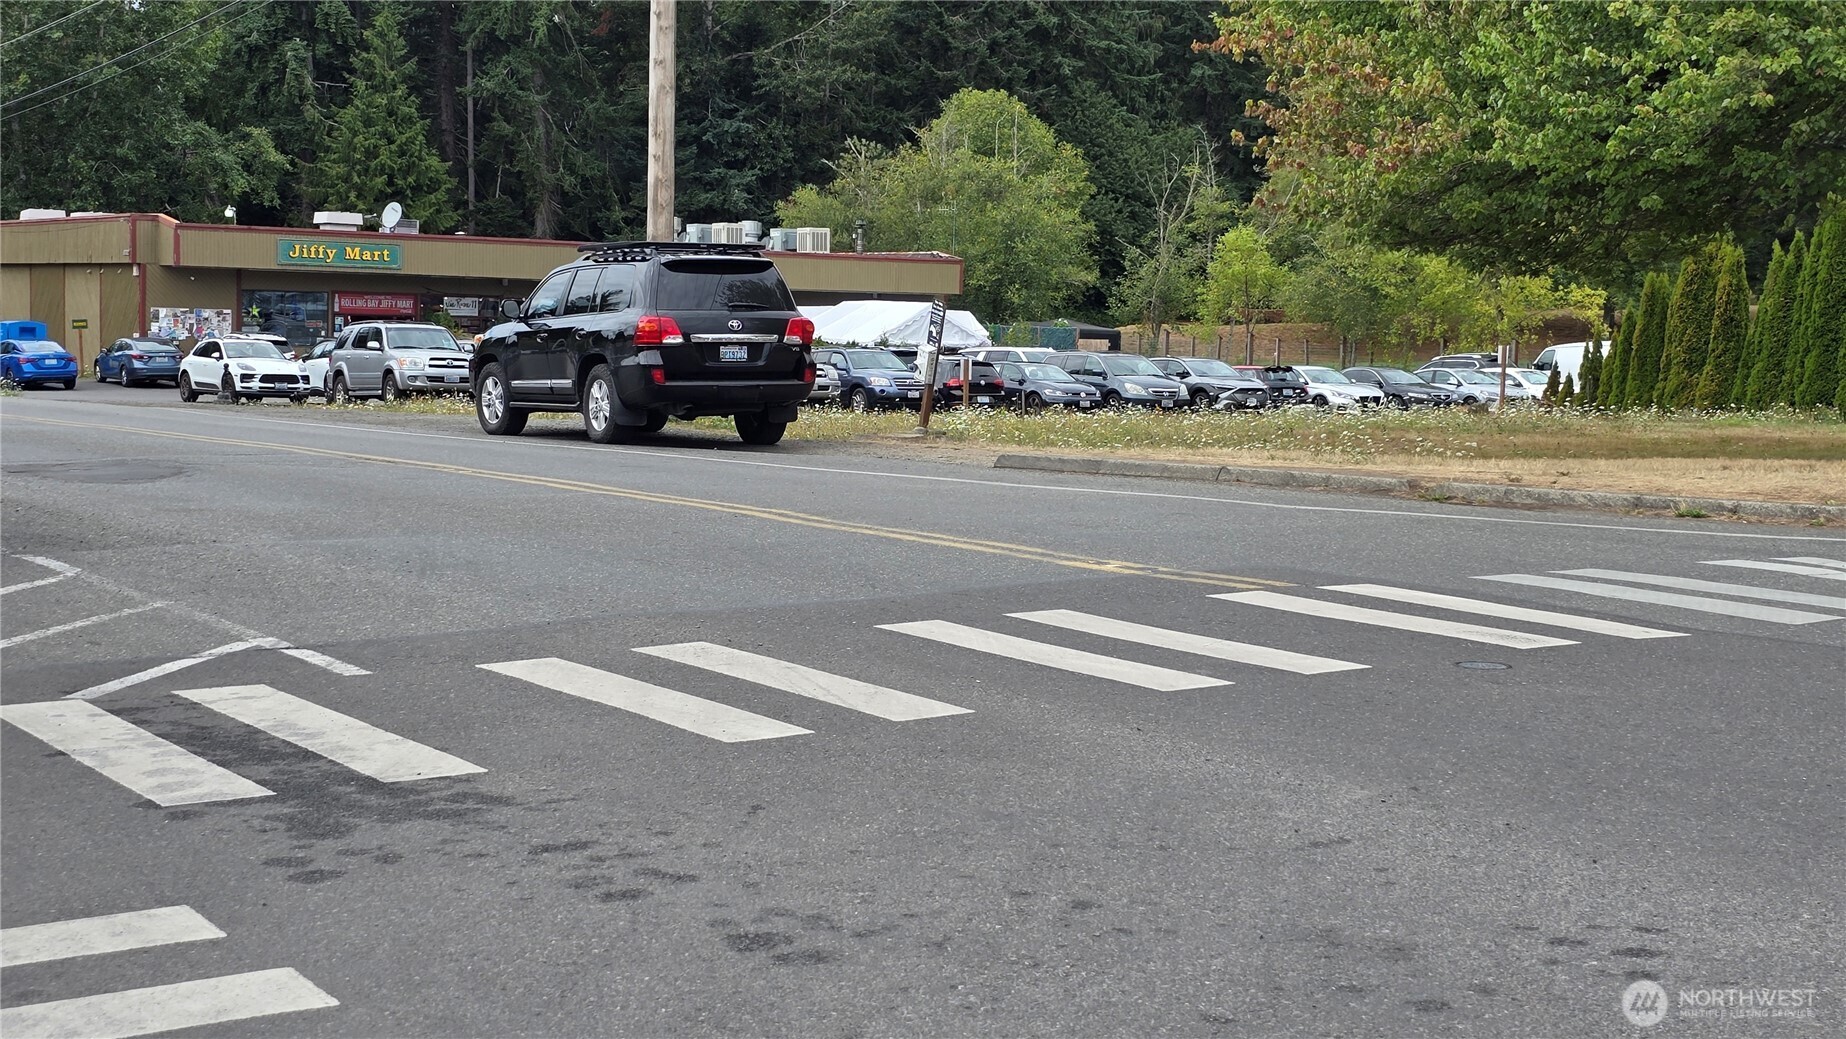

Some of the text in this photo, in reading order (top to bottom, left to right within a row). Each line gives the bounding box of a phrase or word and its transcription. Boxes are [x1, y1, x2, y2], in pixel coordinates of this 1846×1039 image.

[289, 244, 391, 263] Jiffy Mart
[341, 298, 414, 309] ROLLING BAY JIFFY MART
